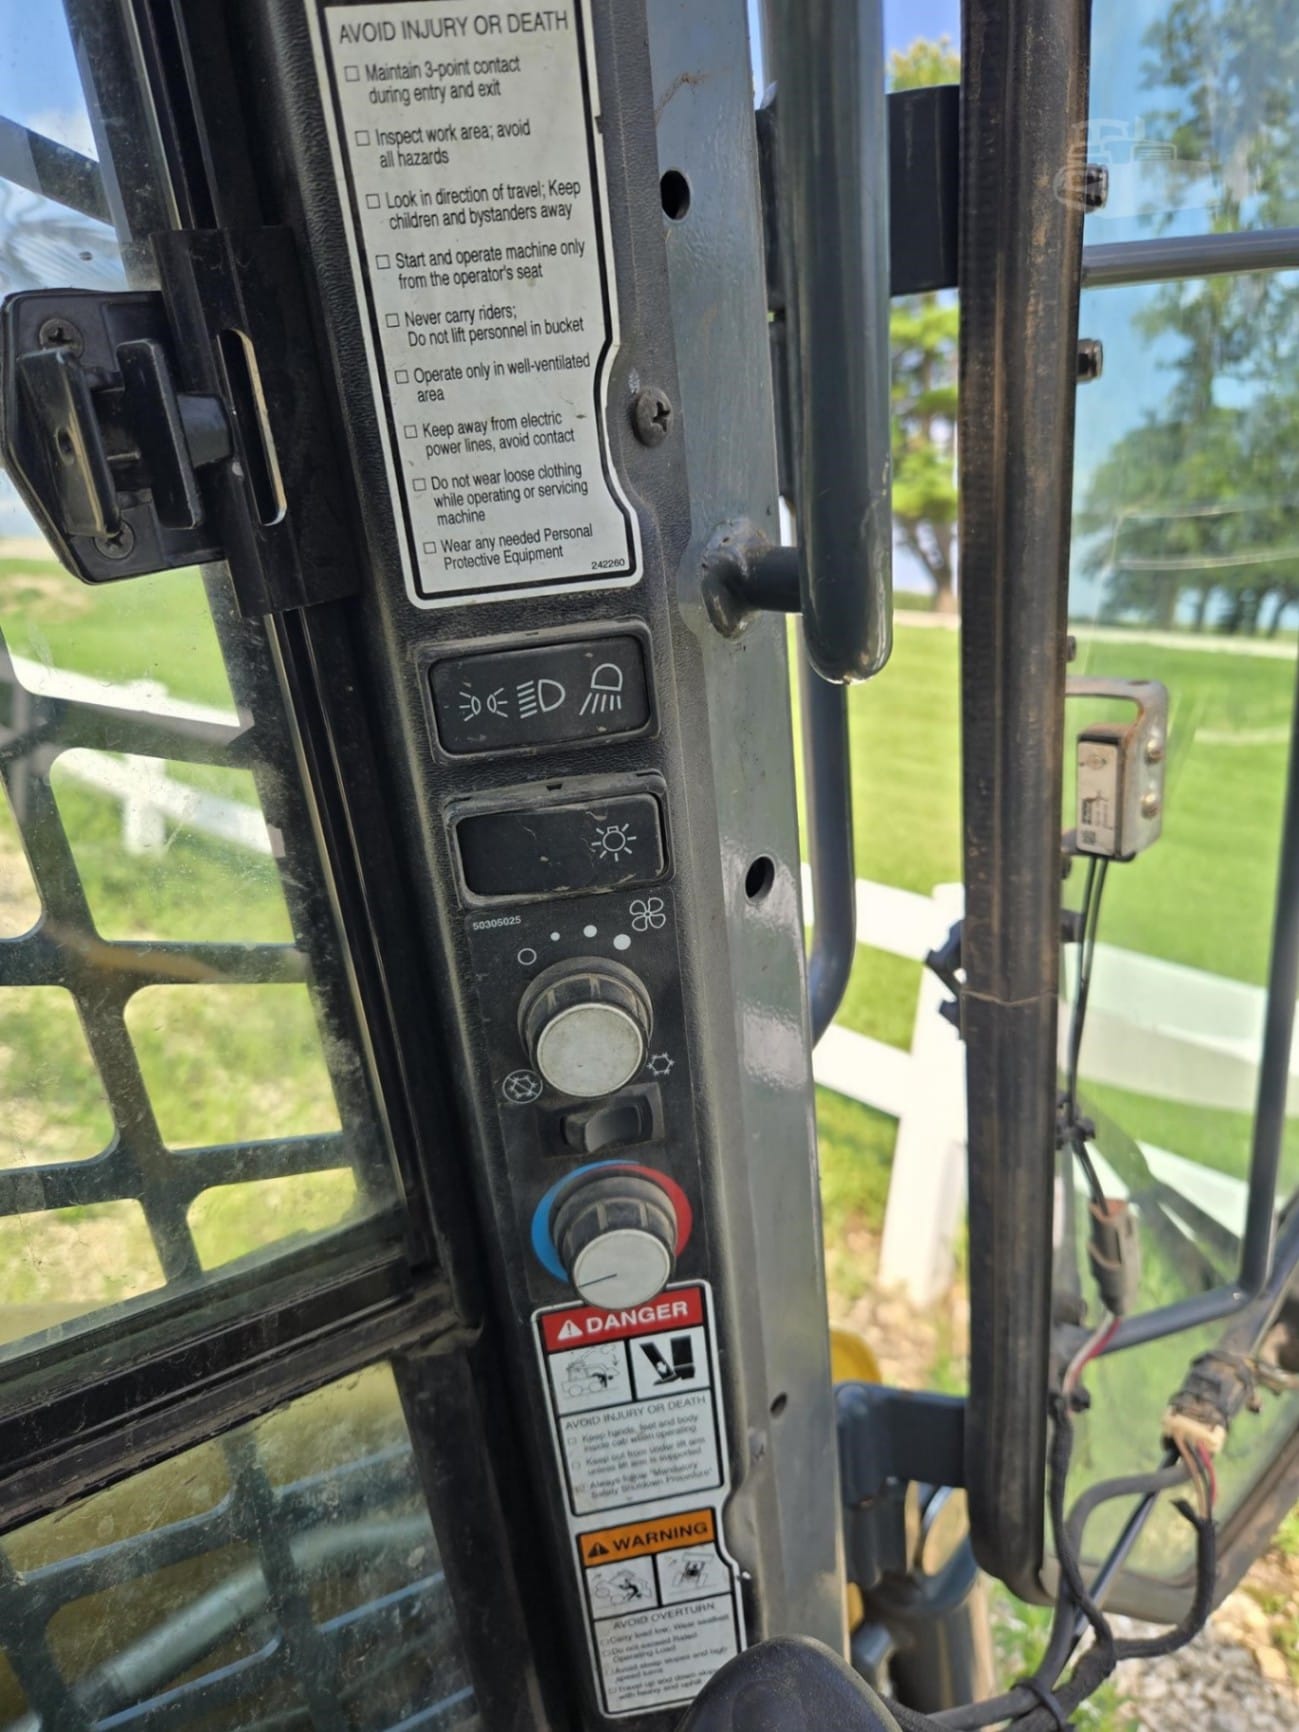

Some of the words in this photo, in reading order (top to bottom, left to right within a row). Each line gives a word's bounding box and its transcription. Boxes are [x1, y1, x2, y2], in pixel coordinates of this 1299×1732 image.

[339, 21, 396, 44] AVOID
[401, 16, 468, 40] INJURY
[474, 15, 502, 36] OR
[508, 10, 568, 33] DEATH
[365, 61, 421, 82] Maintain
[425, 58, 471, 79] 3-point
[473, 56, 520, 74] contact
[369, 87, 410, 106] during
[414, 85, 446, 103] entry
[450, 82, 474, 98] and
[478, 80, 501, 96] exit
[375, 127, 423, 148] Inspect
[426, 124, 456, 142] work
[461, 124, 495, 141] area;
[497, 120, 531, 137] avoid
[380, 152, 394, 168] all
[397, 148, 449, 167] hazards
[385, 191, 417, 208] Look
[420, 190, 433, 206] in
[436, 186, 489, 205] direction
[492, 184, 504, 201] of
[506, 181, 546, 200] travel;
[549, 180, 581, 198] Keep
[389, 210, 439, 230] children
[443, 208, 466, 225] and
[469, 204, 537, 227] bystanders
[541, 203, 572, 220] away
[395, 251, 426, 269] Start
[429, 249, 452, 265] and
[456, 247, 502, 267] operate
[506, 242, 557, 260] machine
[560, 239, 585, 259] only
[398, 273, 427, 289] from
[430, 270, 450, 286] the
[453, 264, 514, 287] operator's
[517, 264, 543, 278] seat
[405, 309, 441, 328] Never
[445, 309, 476, 326] carry
[478, 304, 517, 322] riders;
[408, 331, 427, 346] Do
[429, 329, 449, 344] not
[451, 328, 466, 342] lift
[469, 323, 528, 345] personnel
[530, 322, 542, 336] in
[545, 317, 584, 334] bucket
[414, 365, 463, 386] Operate
[466, 363, 491, 381] only
[493, 361, 505, 376] in
[507, 353, 590, 374] well-ventilated
[417, 388, 445, 402] area
[423, 421, 454, 440] Keep
[457, 419, 488, 436] away
[491, 415, 518, 430] from
[521, 411, 562, 428] electric
[426, 440, 462, 460] power
[464, 436, 496, 452] lines,
[499, 434, 530, 449] avoid
[532, 429, 575, 445] contact
[431, 476, 449, 490] Do
[451, 473, 471, 488] not
[473, 471, 501, 485] wear
[503, 467, 535, 482] loose
[538, 464, 582, 482] clothing
[434, 493, 464, 508] while
[467, 486, 521, 508] operating
[524, 485, 536, 499] or
[538, 480, 588, 498] servicing
[437, 510, 486, 526] machine
[440, 537, 472, 554] Wear
[475, 534, 496, 551] any
[499, 530, 541, 547] needed
[544, 524, 593, 542] Personal
[444, 552, 501, 570] Protective
[504, 545, 564, 566] Equipment
[472, 915, 521, 930] 50305025
[586, 1301, 688, 1334] DANGER
[565, 1416, 601, 1430] AVOID
[604, 1406, 644, 1423] INJURY
[647, 1403, 665, 1414] OR
[668, 1396, 706, 1410] DEATH
[613, 1522, 708, 1551] WARNING
[613, 1616, 649, 1630] AVOID
[651, 1602, 715, 1622] OVERTURN
